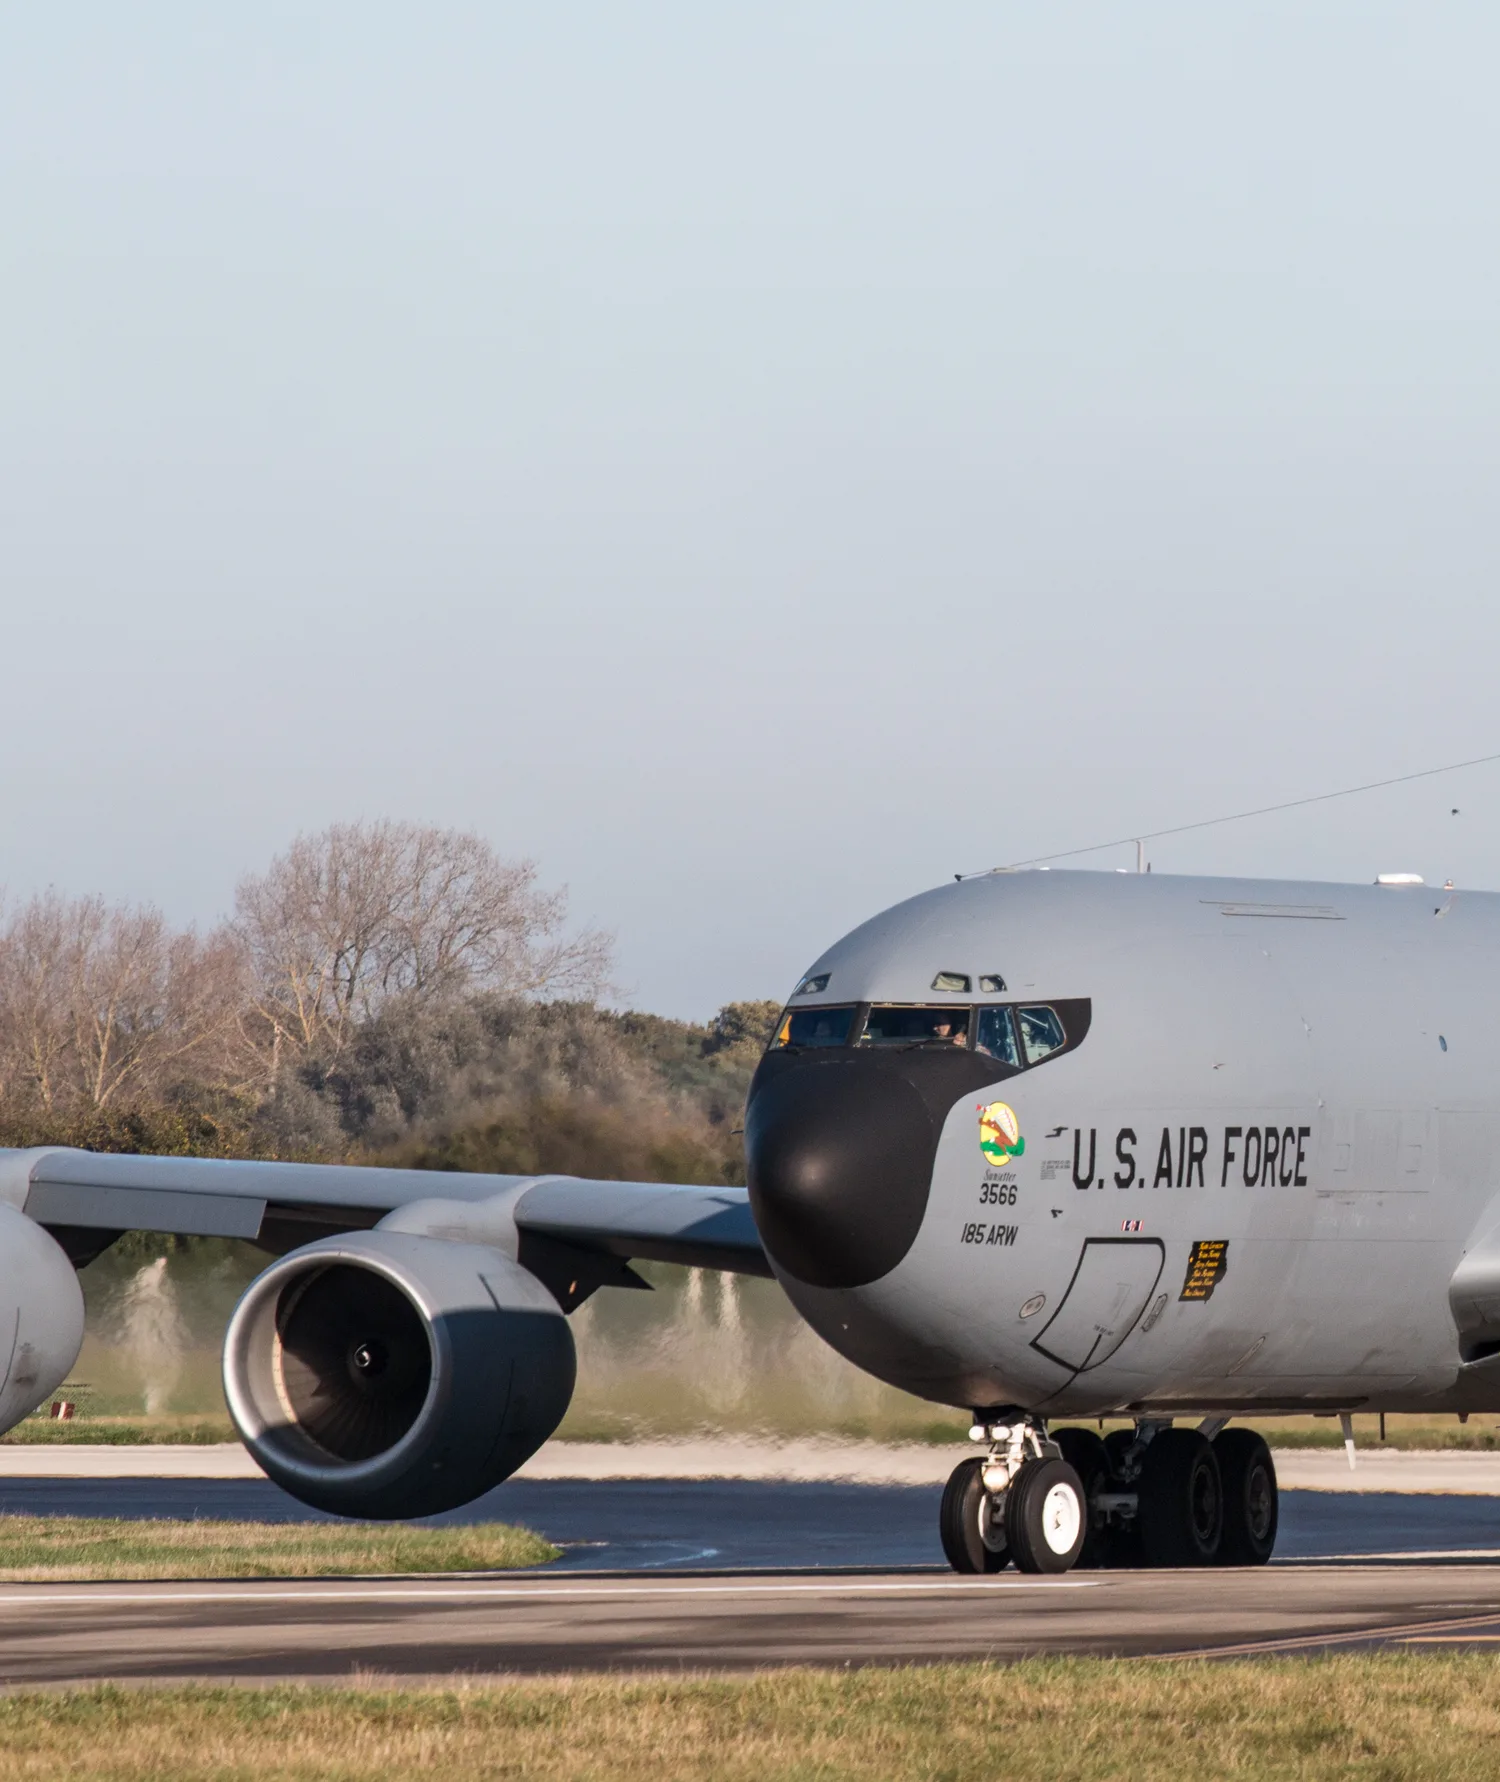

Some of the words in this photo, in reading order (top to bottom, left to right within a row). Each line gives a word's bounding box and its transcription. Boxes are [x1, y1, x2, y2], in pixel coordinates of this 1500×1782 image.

[1153, 1126, 1208, 1188] AIR
[1221, 1126, 1311, 1188] FORCE
[979, 1182, 1018, 1206] 3566
[960, 1222, 987, 1245] 185
[985, 1224, 1019, 1247] ARW
